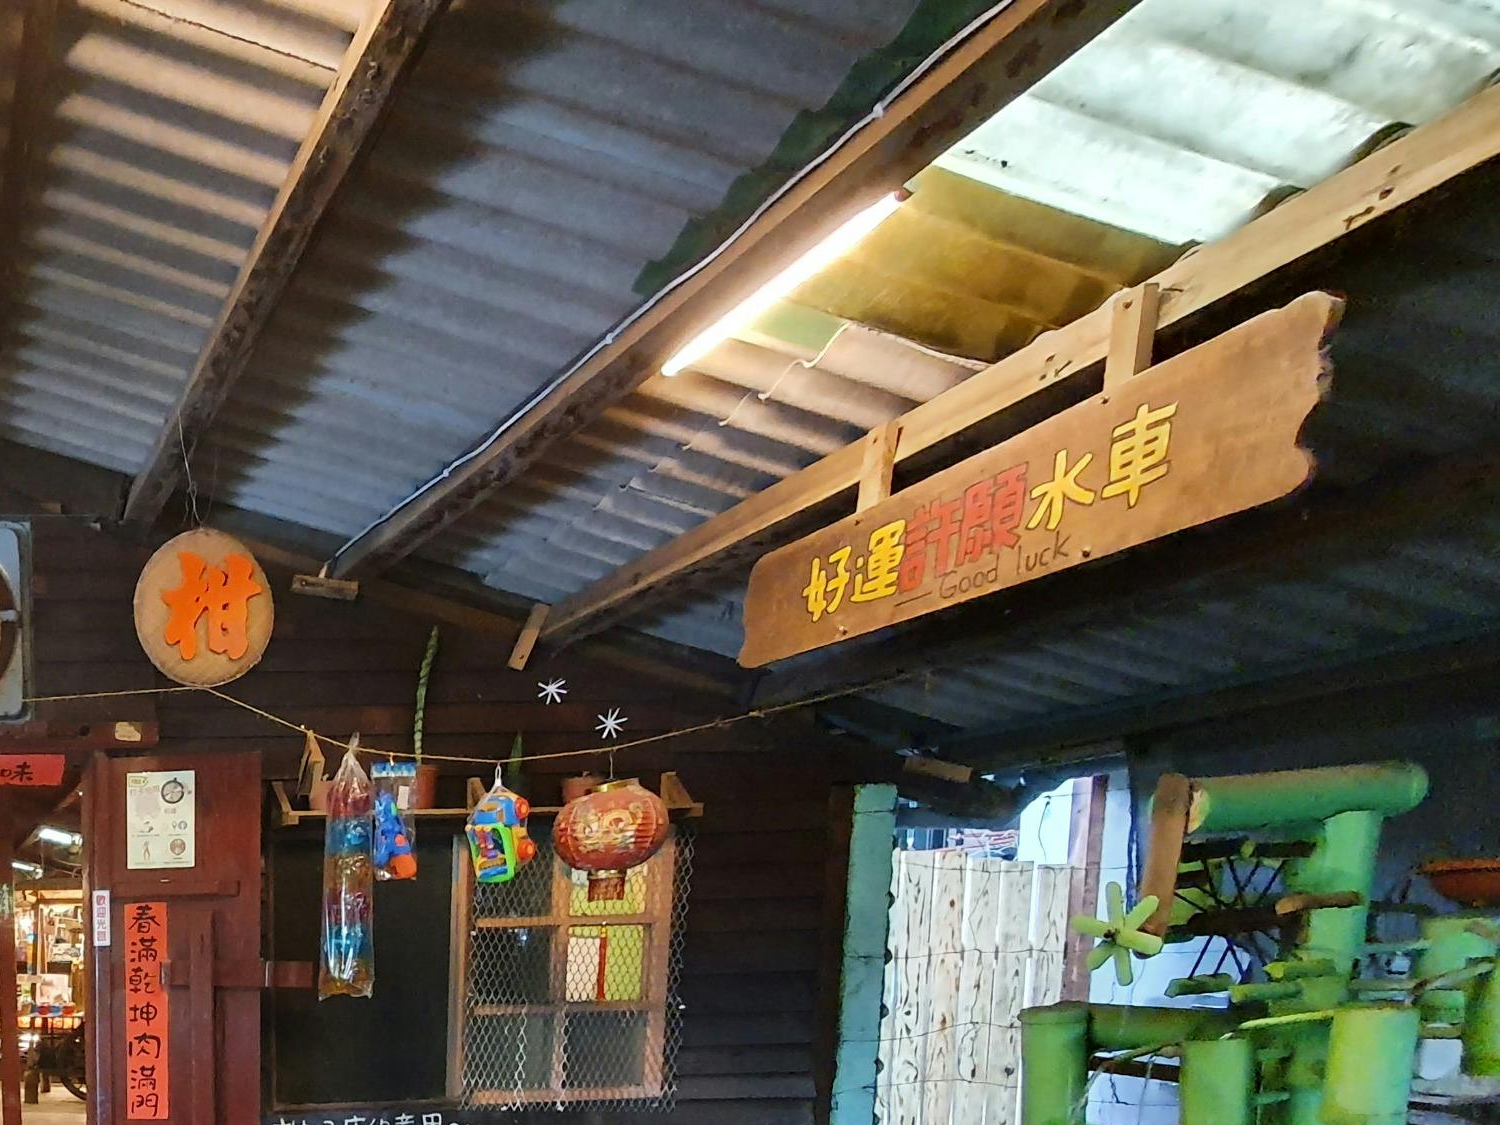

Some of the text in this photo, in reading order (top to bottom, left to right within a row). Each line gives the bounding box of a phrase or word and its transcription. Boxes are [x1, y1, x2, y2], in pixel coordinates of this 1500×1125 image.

[802, 400, 1179, 624] 好運許願水車
[939, 531, 1072, 600] Good luck
[162, 551, 262, 661] 柑
[128, 905, 161, 1117] 春滿乾坤肉滿門
